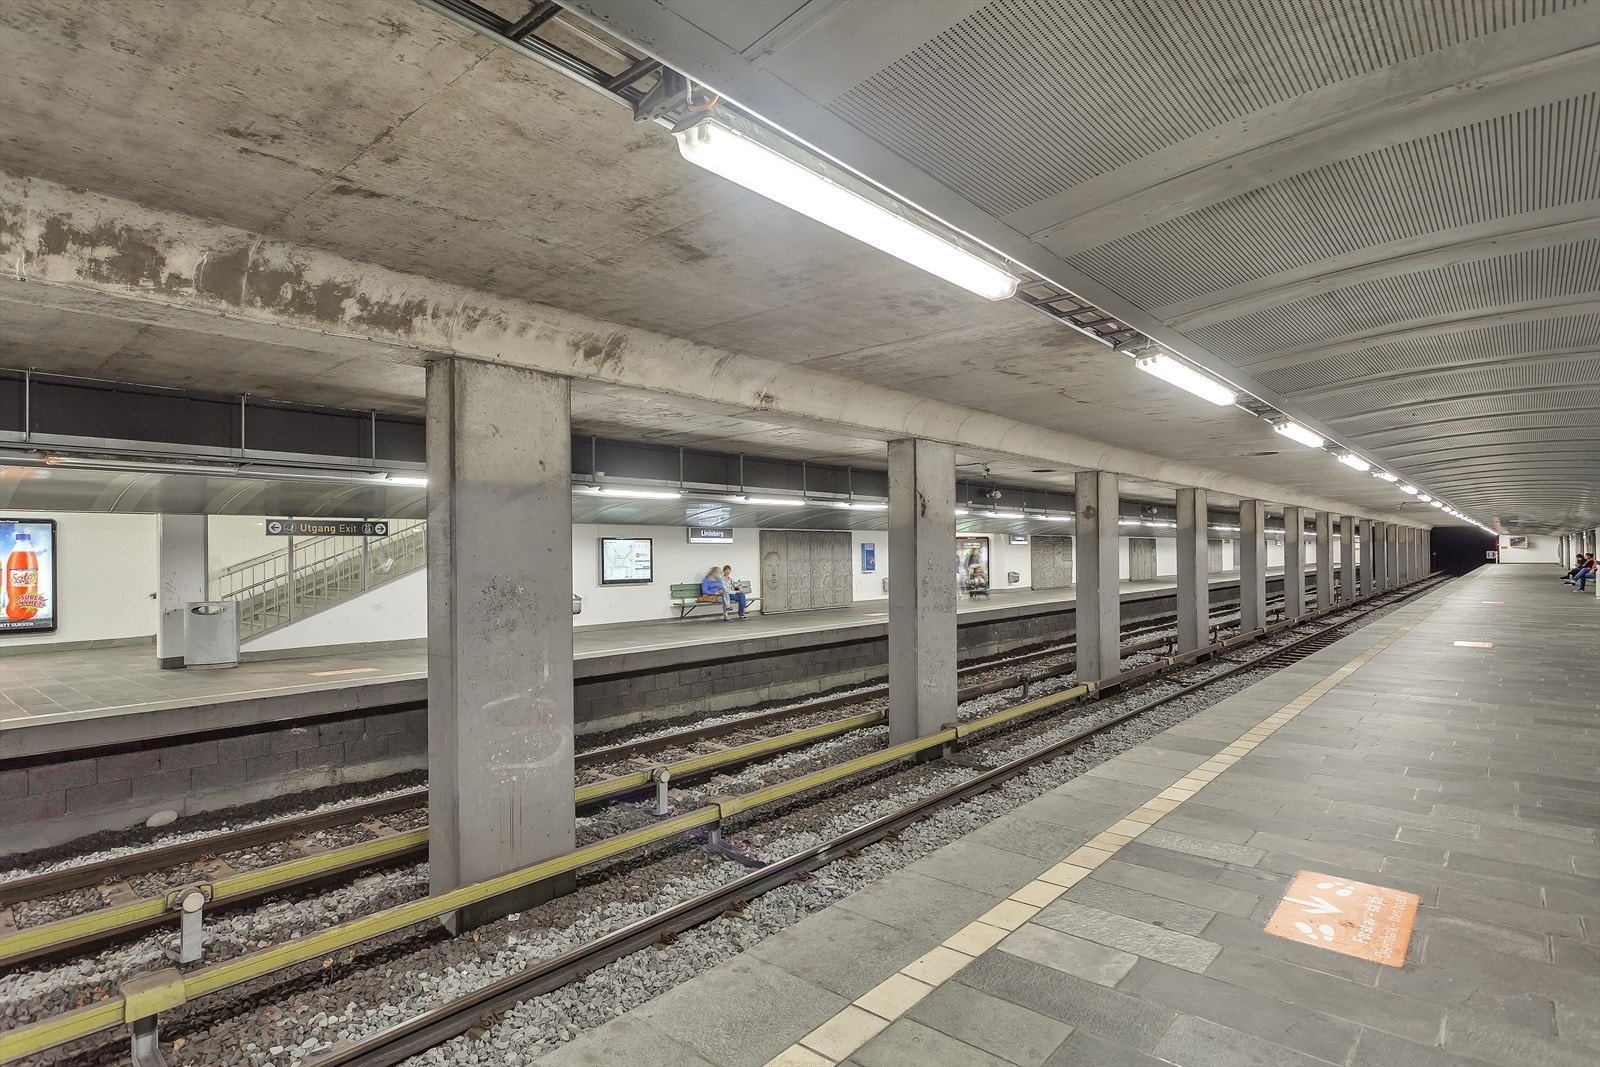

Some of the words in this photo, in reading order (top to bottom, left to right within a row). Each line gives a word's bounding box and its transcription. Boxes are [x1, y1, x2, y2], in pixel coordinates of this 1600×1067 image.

[300, 524, 336, 534] Utgang
[340, 524, 358, 532] Exit
[701, 530, 724, 538] Lindeberg
